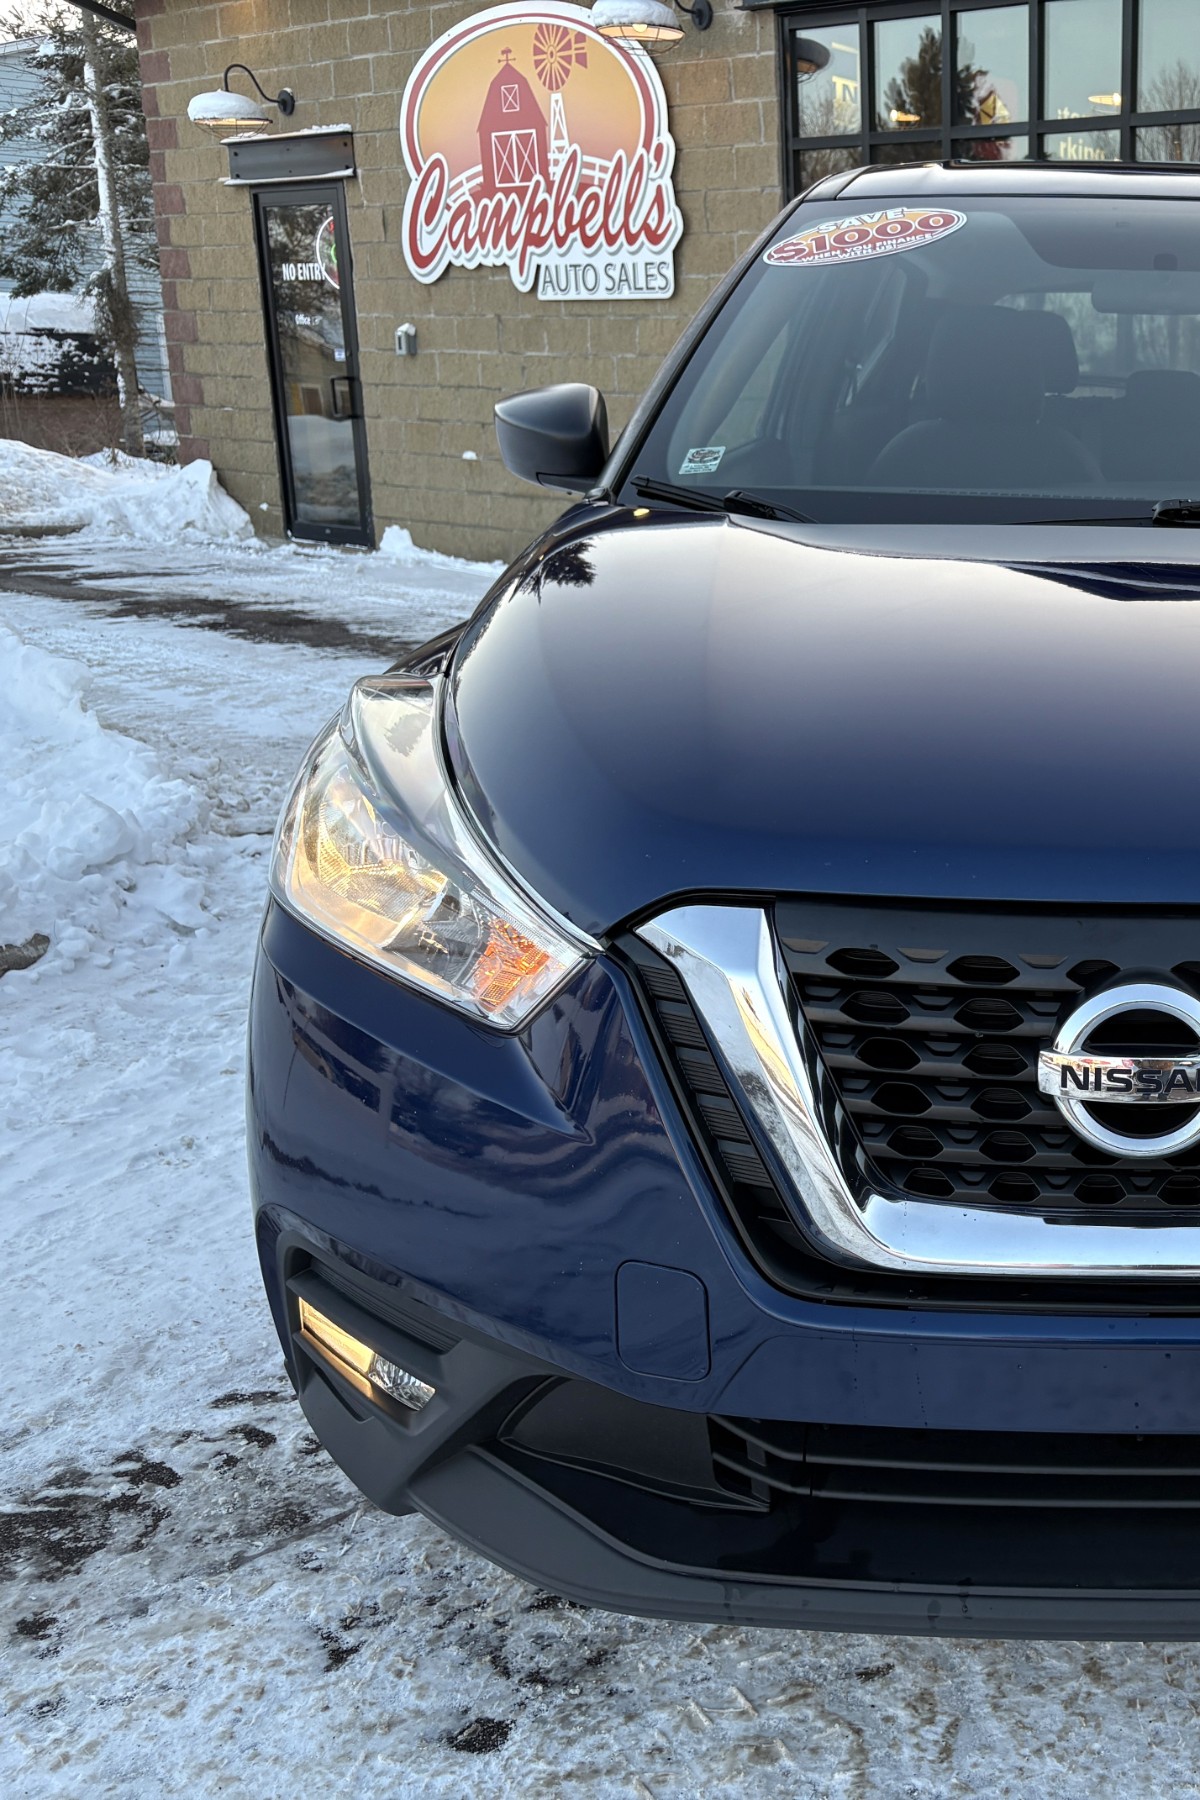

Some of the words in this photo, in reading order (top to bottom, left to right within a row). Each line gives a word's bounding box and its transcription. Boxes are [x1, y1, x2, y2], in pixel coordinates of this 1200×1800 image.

[409, 141, 672, 277] Campbell's
[817, 207, 906, 233] SAVE
[770, 212, 959, 262] $1000
[802, 249, 840, 262] WHEN
[845, 243, 872, 253] YOU
[875, 233, 934, 247] FINANCE
[838, 248, 872, 259] WITH
[282, 263, 296, 281] NO
[297, 262, 326, 281] ENTRY
[542, 263, 598, 294] AUTO
[604, 261, 671, 293] SALES
